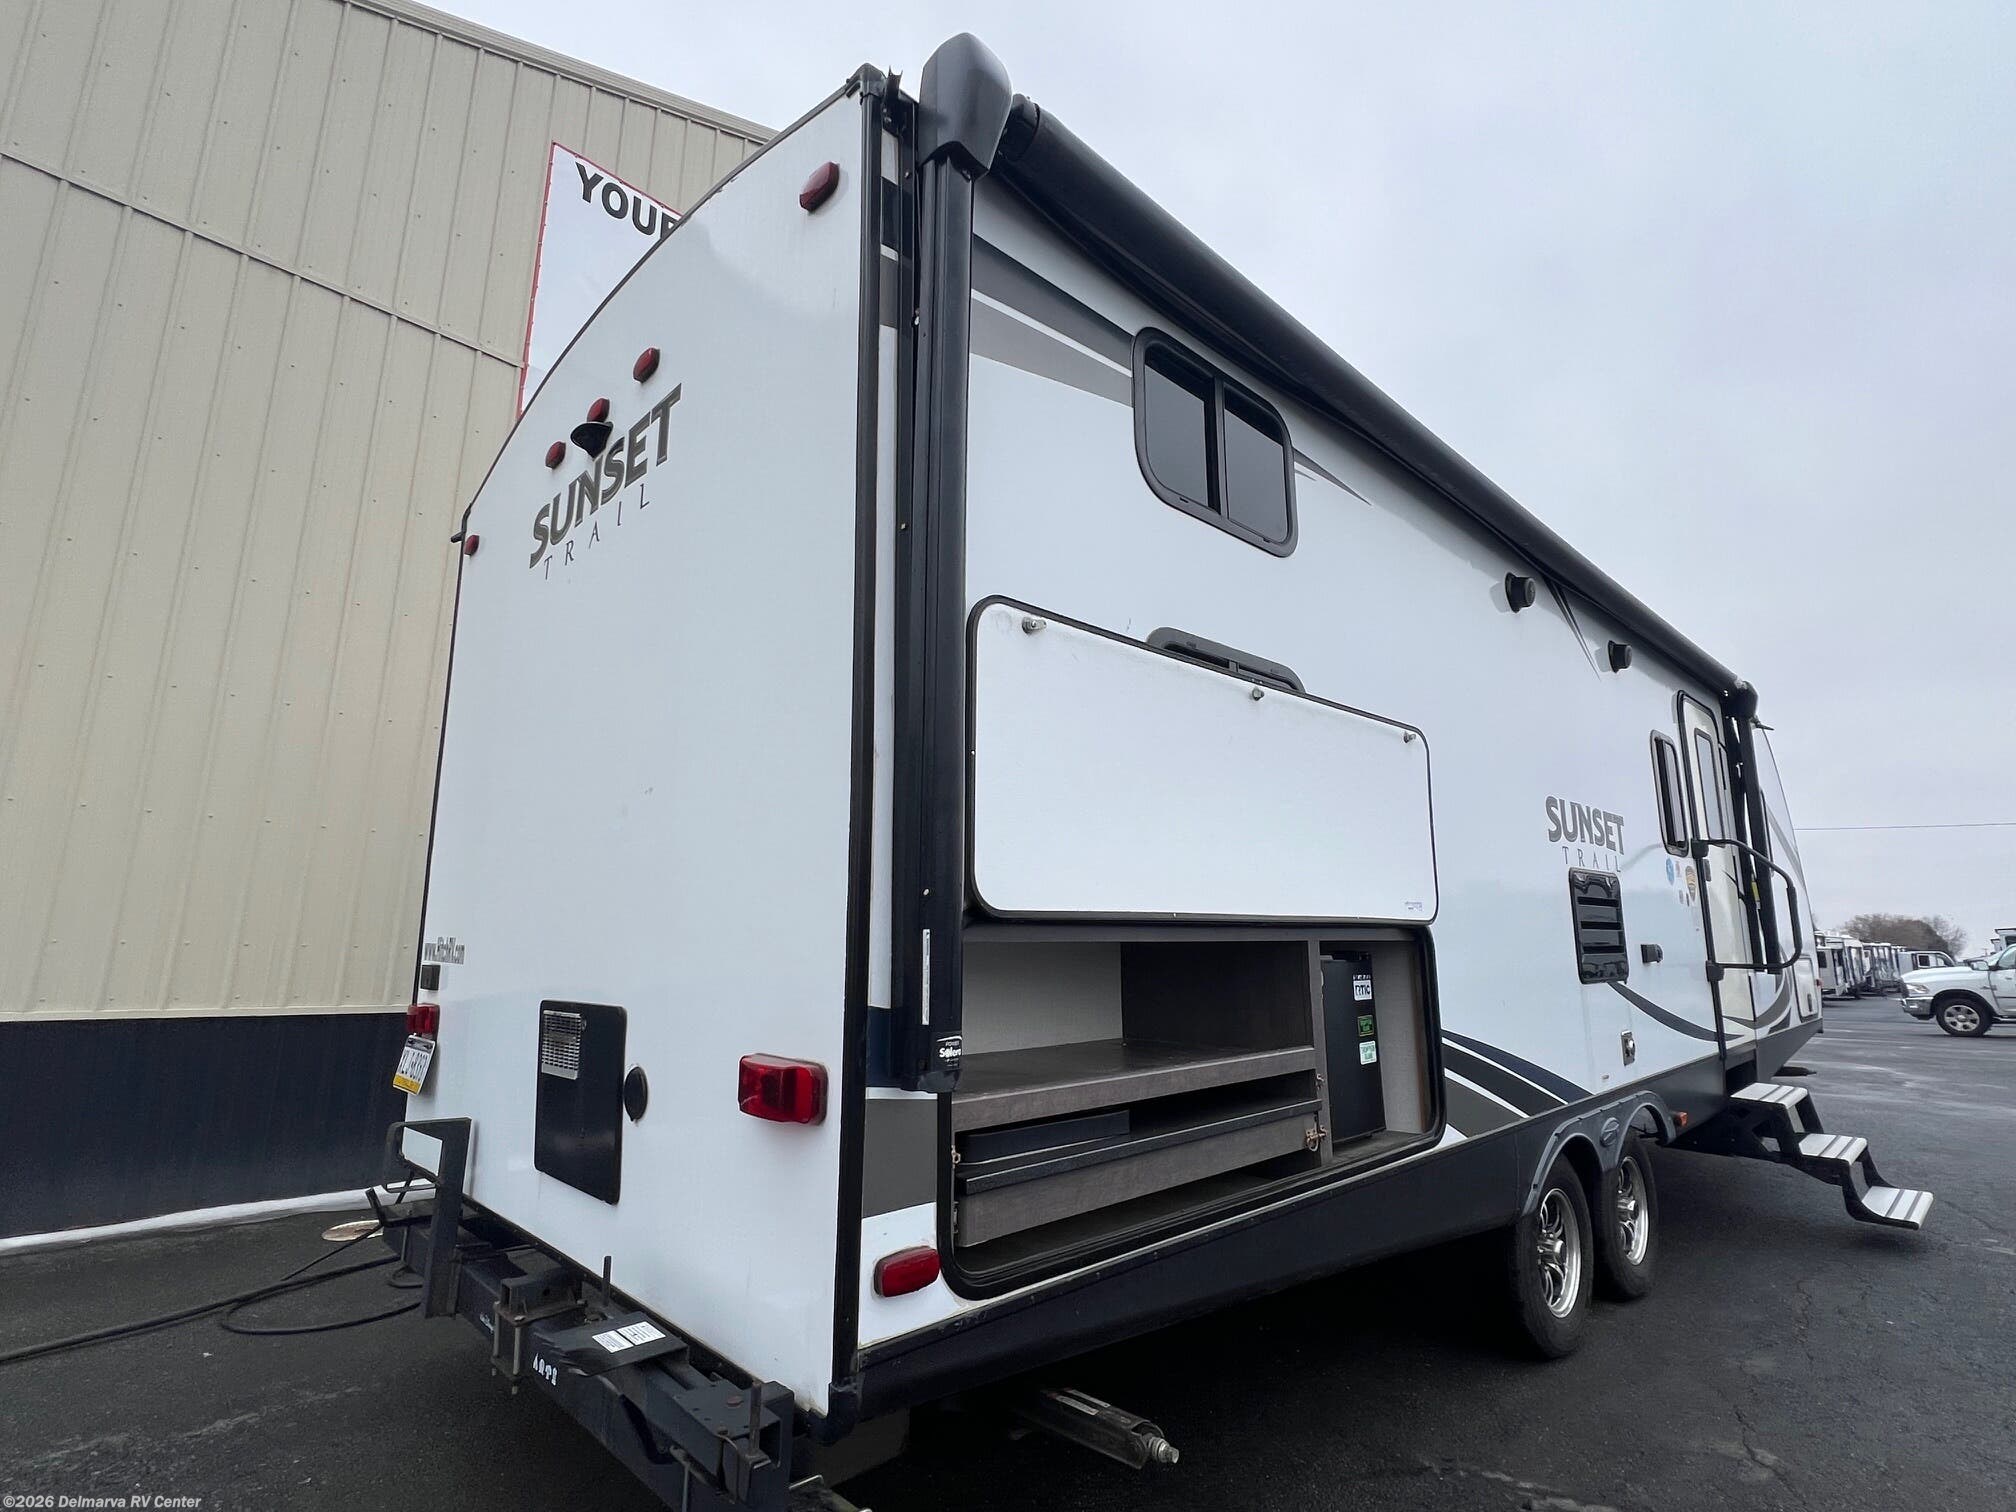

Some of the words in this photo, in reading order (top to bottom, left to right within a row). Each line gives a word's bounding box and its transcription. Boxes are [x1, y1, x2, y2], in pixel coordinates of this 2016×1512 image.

[529, 383, 682, 569] SUNSET
[543, 483, 650, 580] TRAIL
[1545, 796, 1624, 855] SUNSET
[1562, 846, 1622, 873] TRAIL
